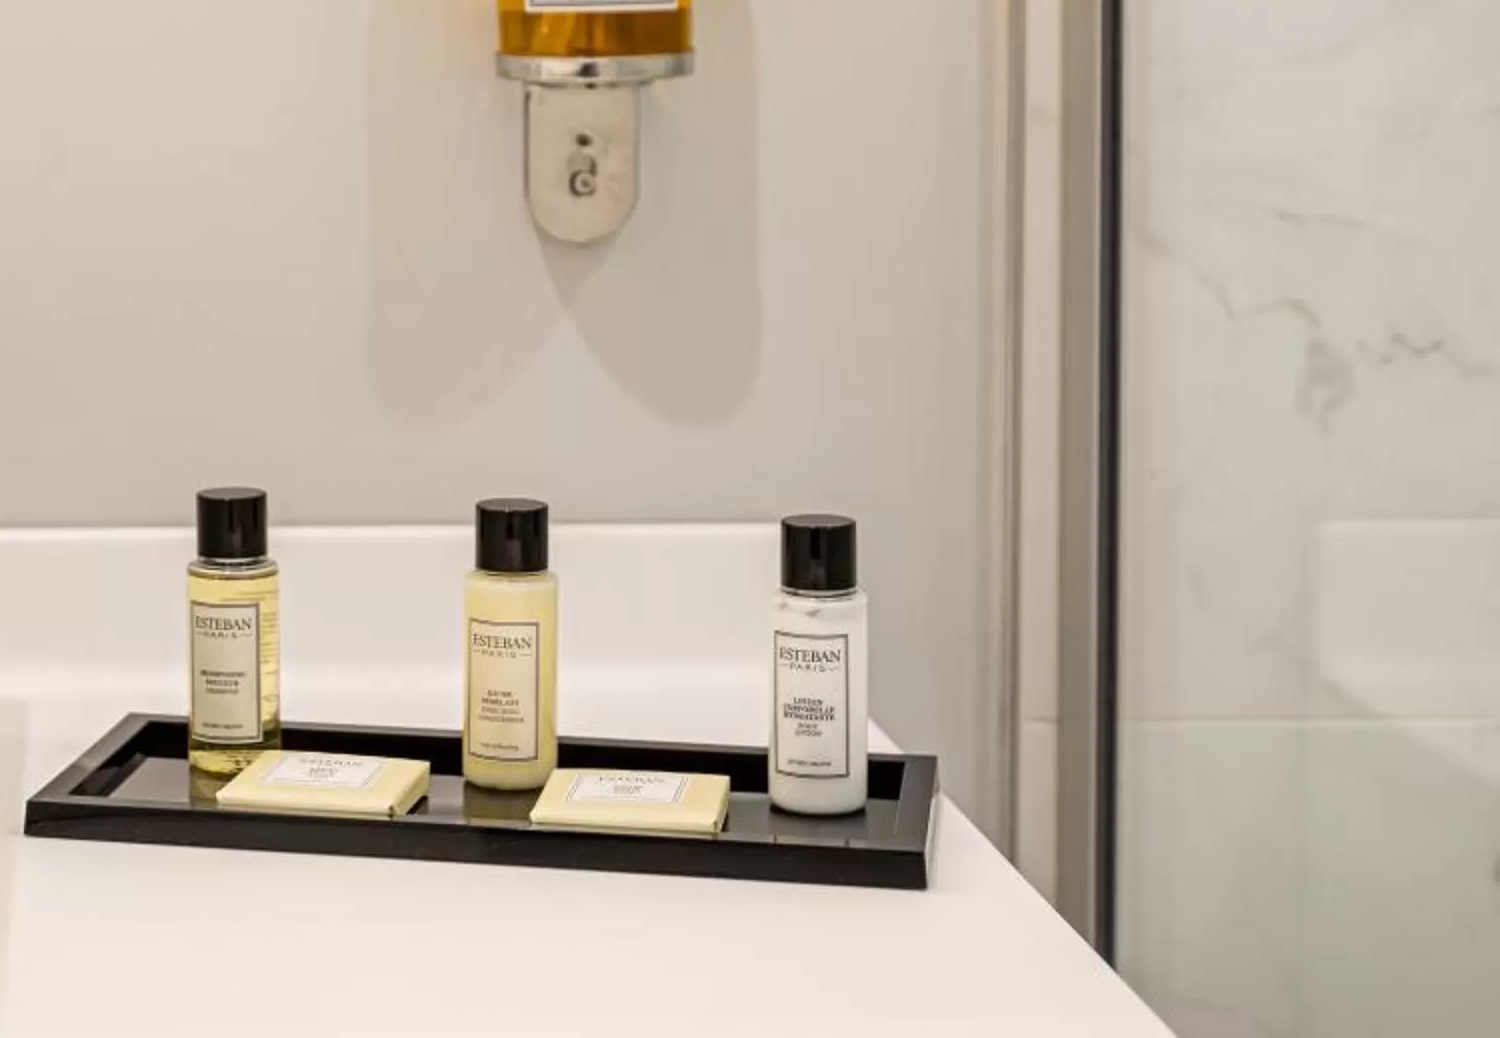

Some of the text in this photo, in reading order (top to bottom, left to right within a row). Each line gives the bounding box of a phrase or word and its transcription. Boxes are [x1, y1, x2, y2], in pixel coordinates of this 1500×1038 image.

[195, 615, 252, 631] ESTEBAN
[473, 633, 533, 649] ESTEBAN
[779, 646, 842, 663] ESTEBAN
[789, 663, 826, 673] PARIS
